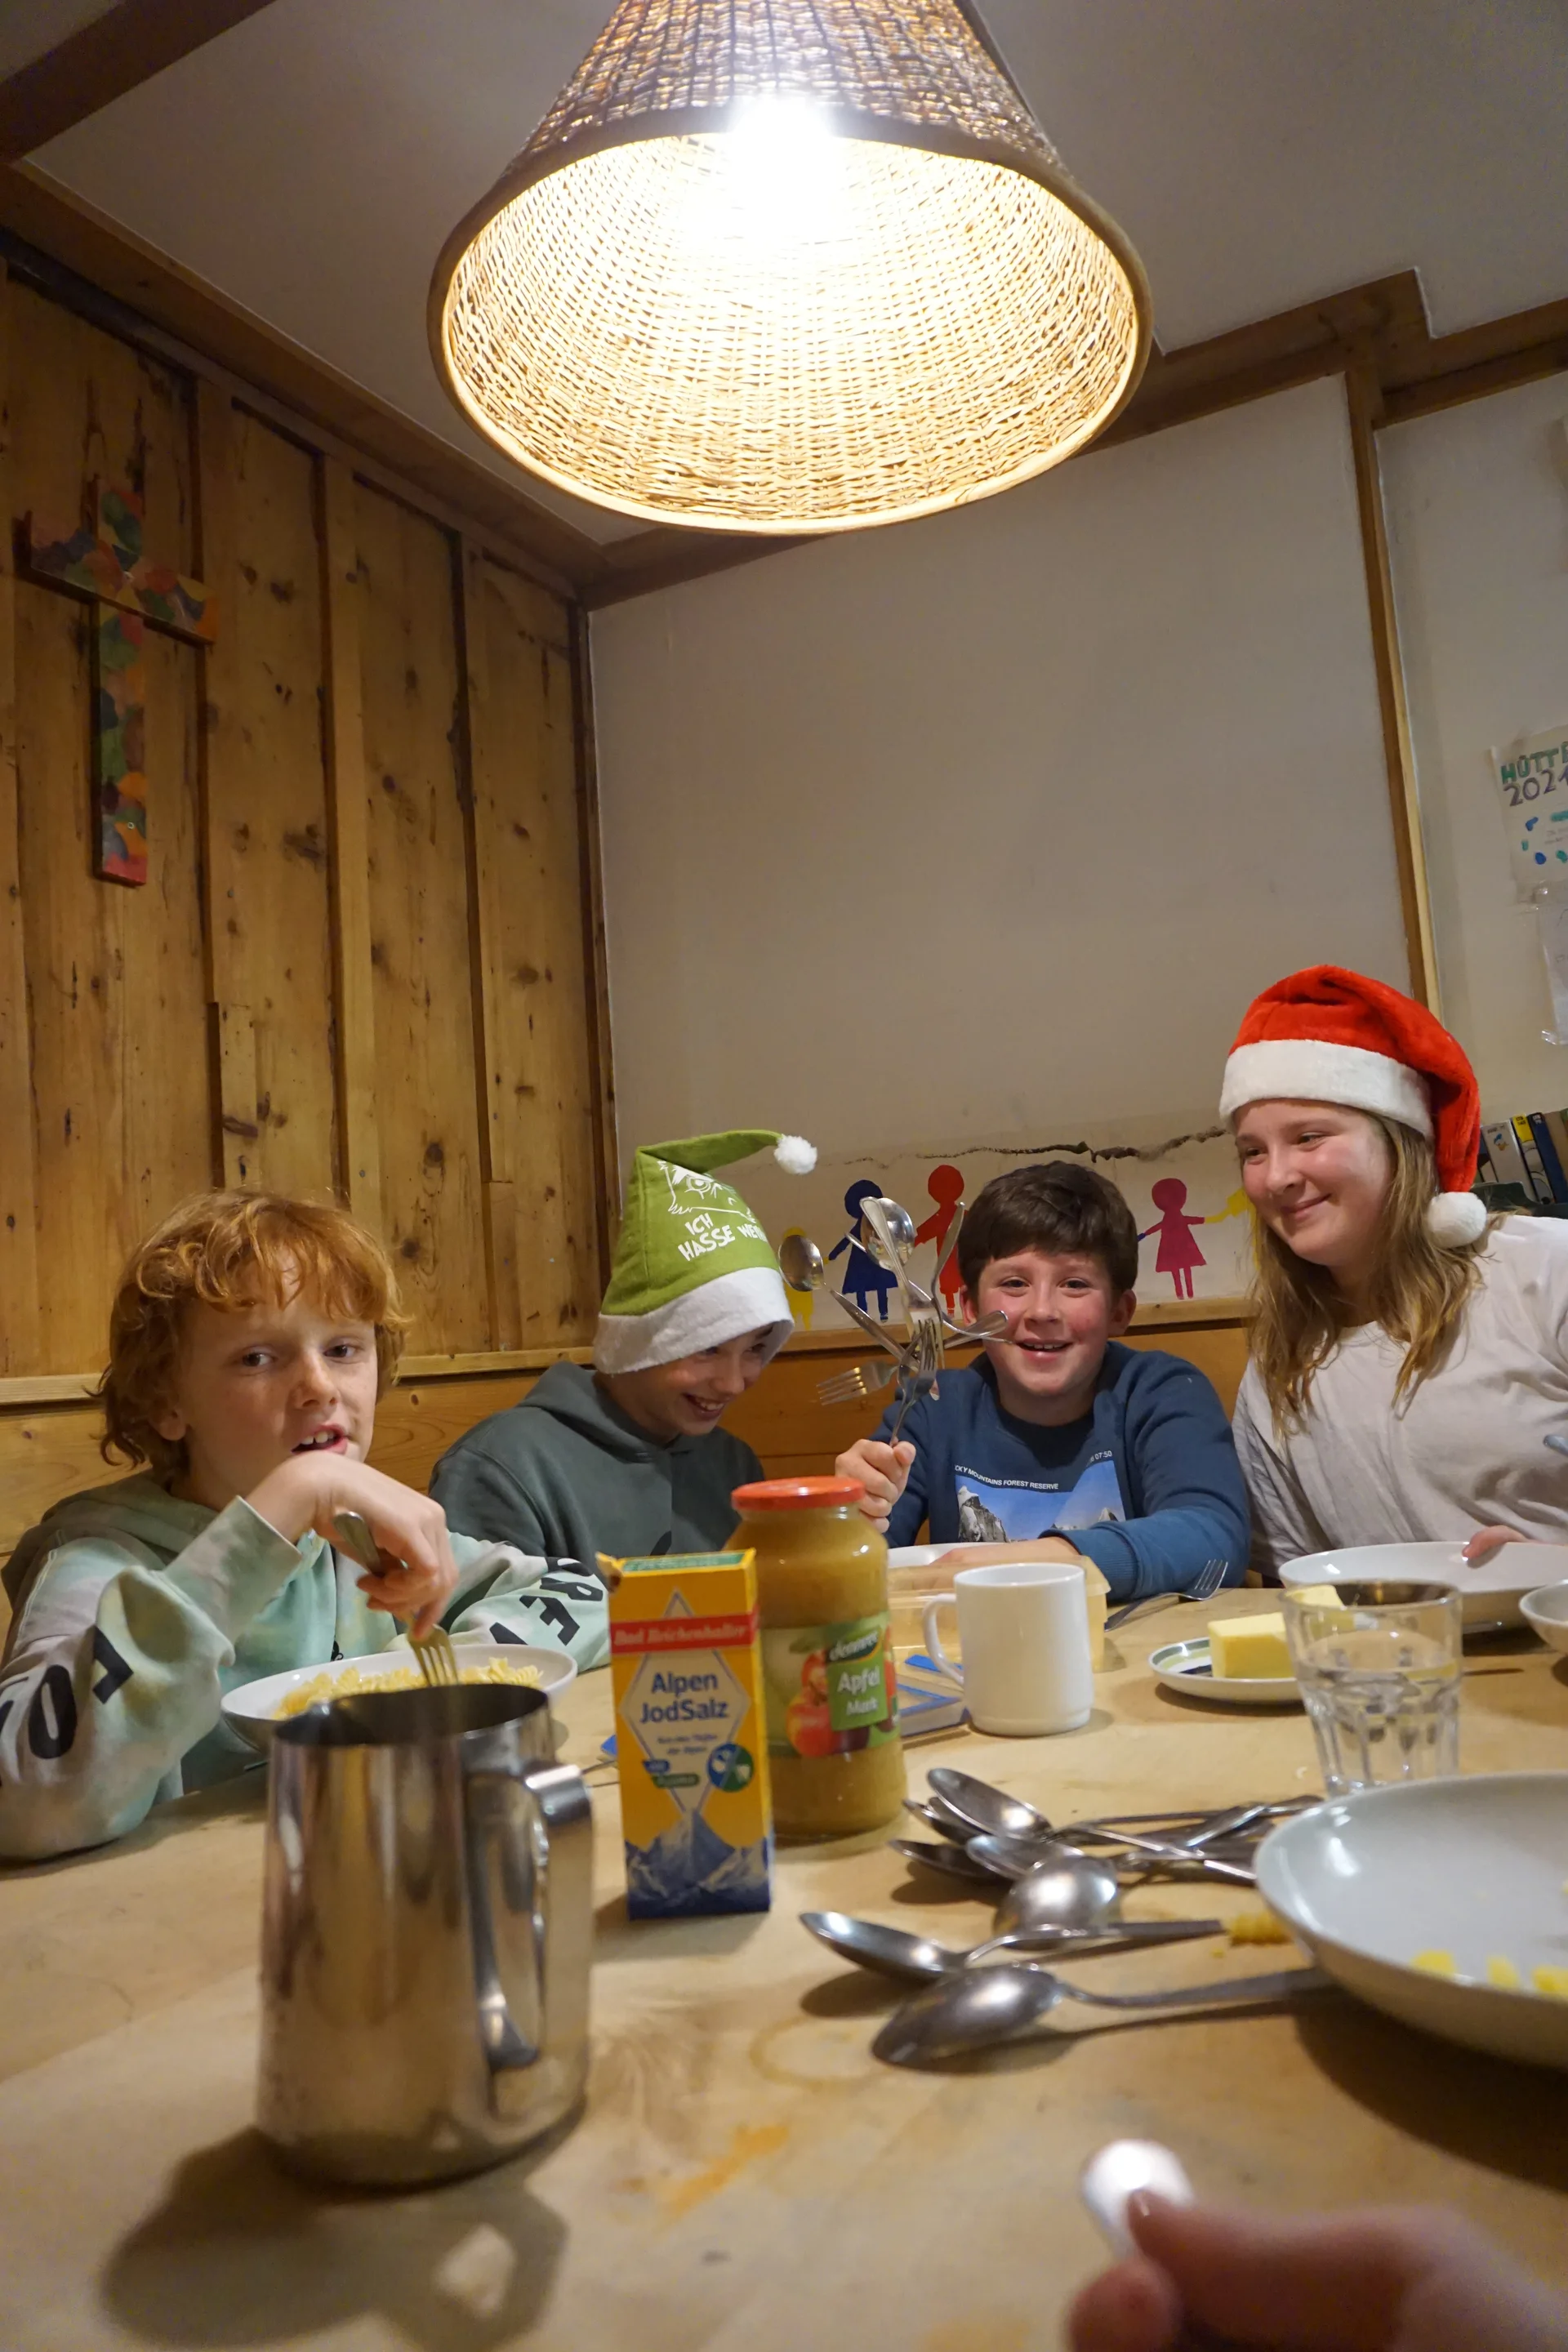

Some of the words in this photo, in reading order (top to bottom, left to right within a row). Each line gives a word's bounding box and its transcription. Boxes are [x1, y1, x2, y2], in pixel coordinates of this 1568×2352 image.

[685, 1213, 714, 1236] ICH
[678, 1225, 736, 1262] HASSE
[1094, 1450, 1112, 1460] 07:50
[955, 1464, 968, 1473] CKY
[968, 1468, 1003, 1486] MOUNTAINS
[651, 1671, 719, 1698] Alpen
[836, 1665, 881, 1695] Apfel
[639, 1698, 729, 1725] JodSalz
